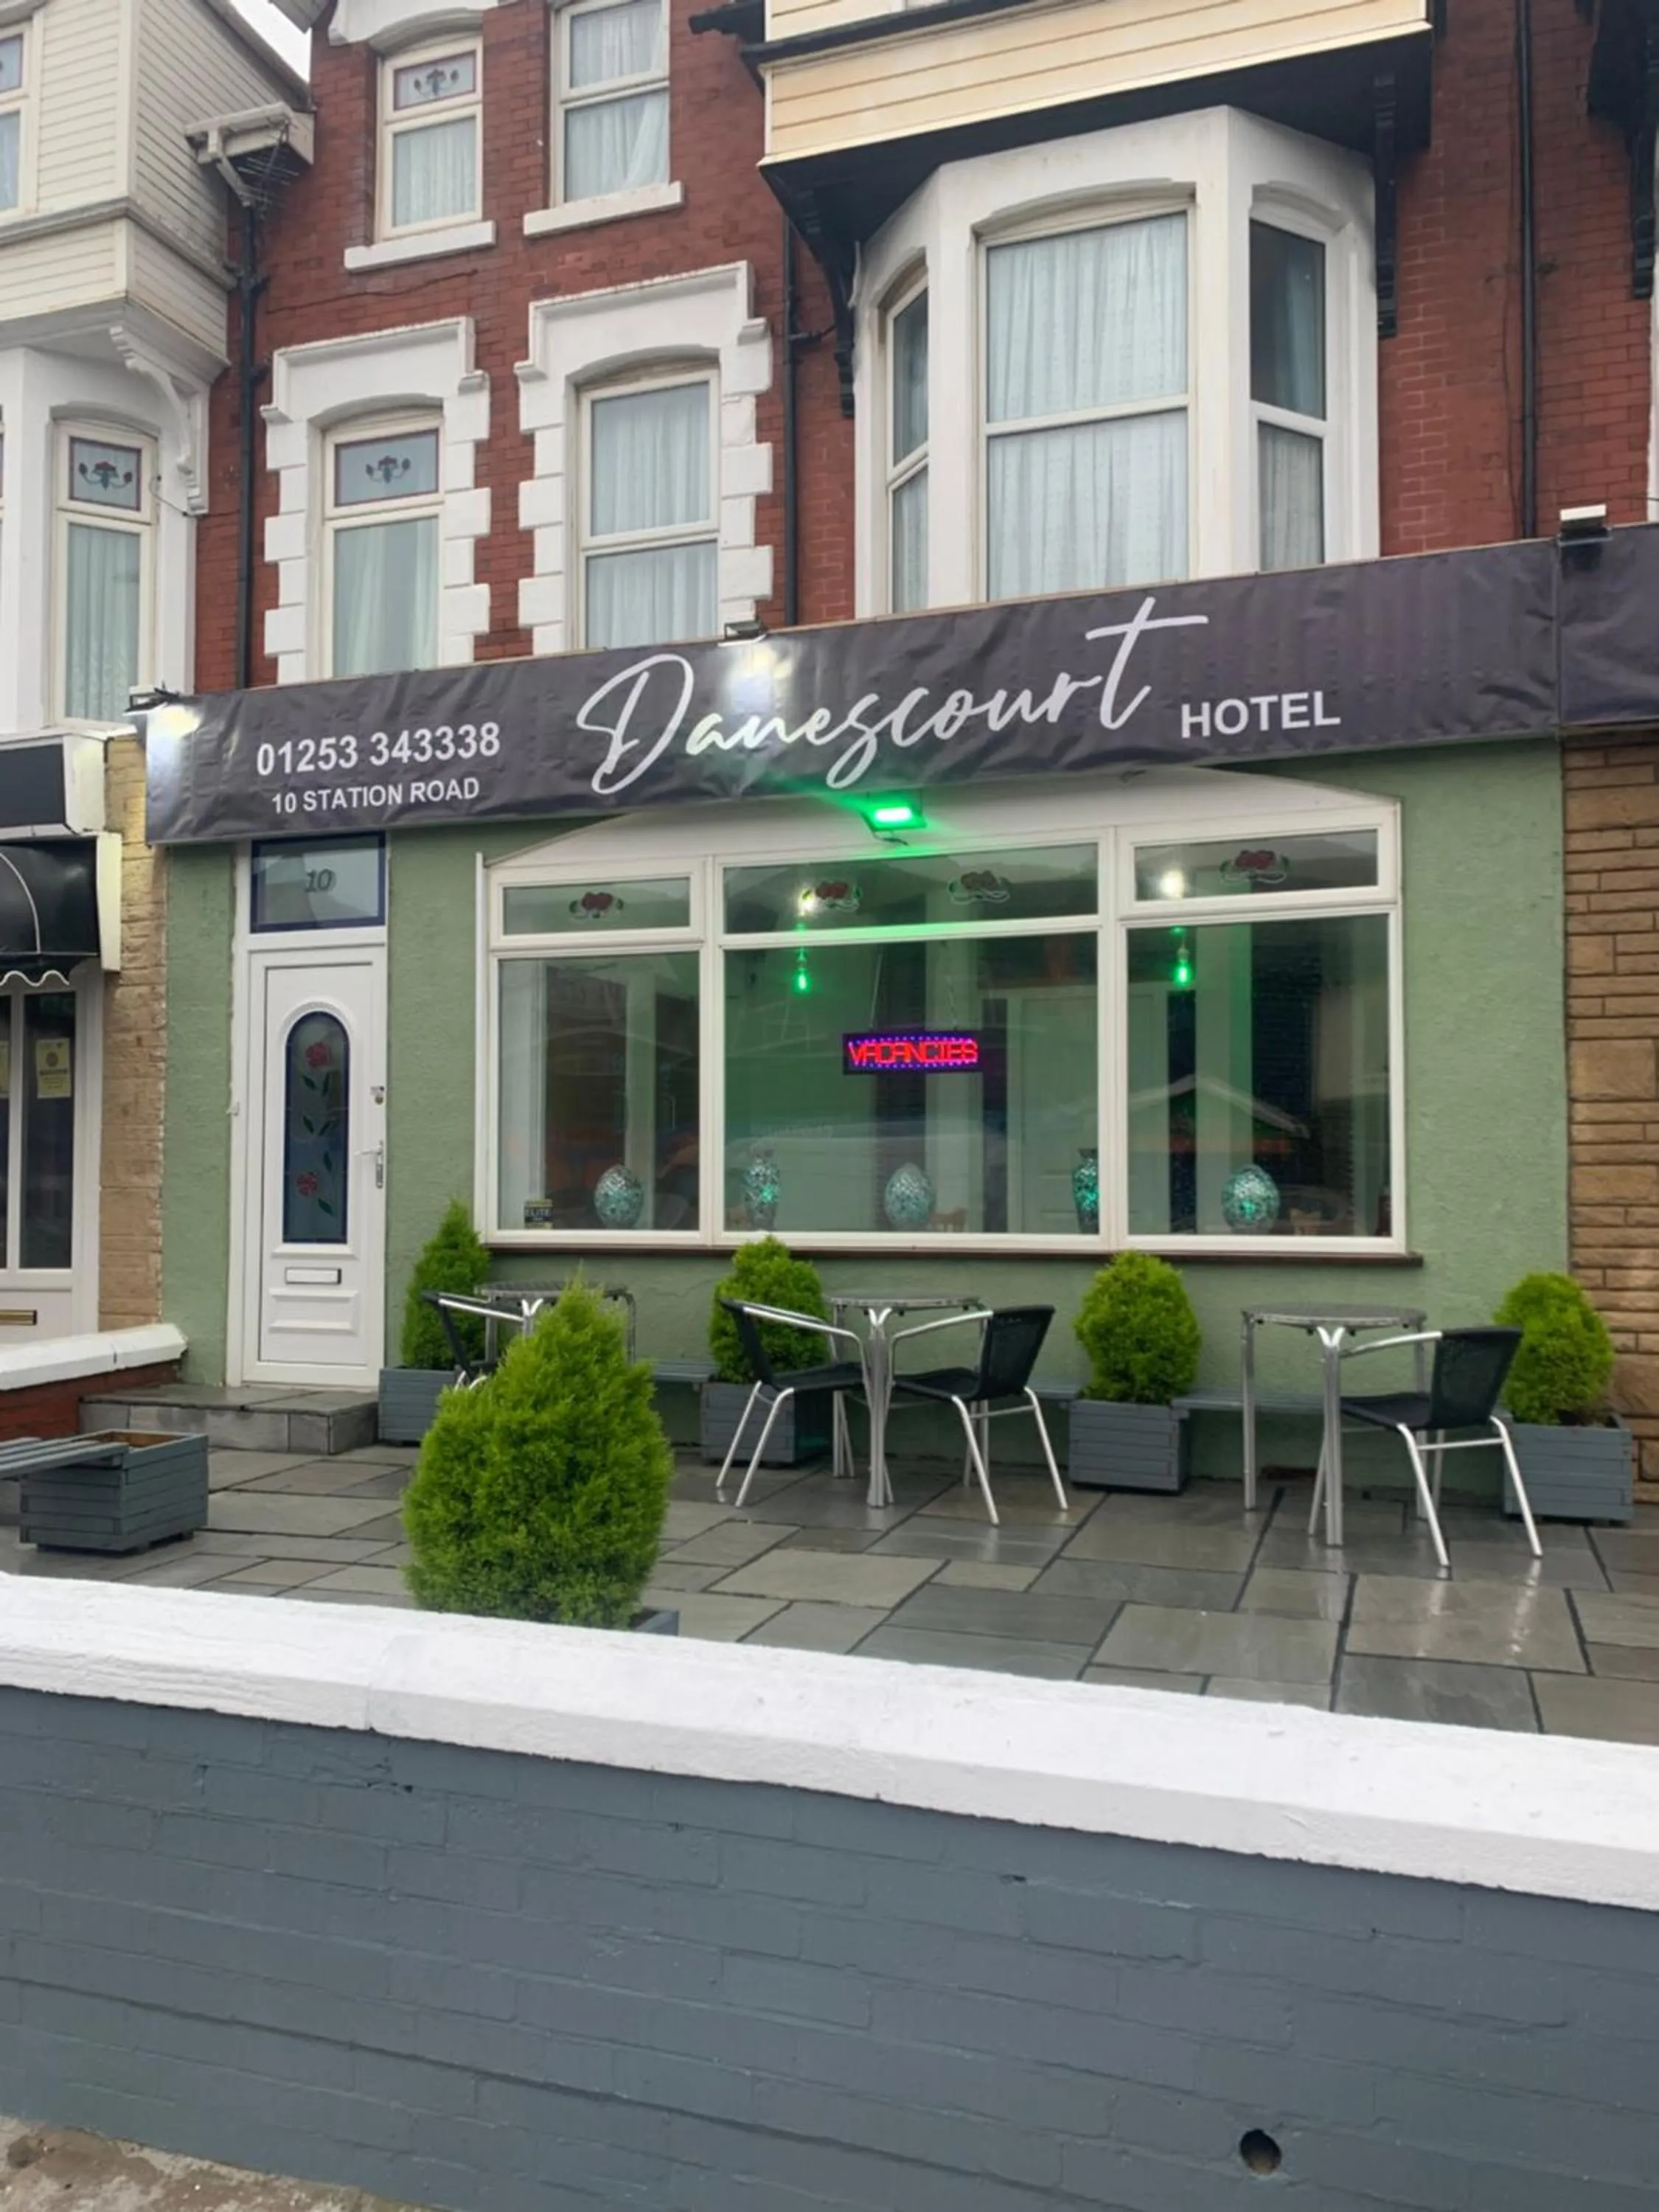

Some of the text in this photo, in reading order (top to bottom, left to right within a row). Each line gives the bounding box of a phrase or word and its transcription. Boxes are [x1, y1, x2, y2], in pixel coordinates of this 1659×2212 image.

[576, 597, 1341, 794] Danescourt HOTEL
[257, 722, 501, 776] 01253 343338
[272, 778, 479, 814] 10 STATION ROAD
[304, 869, 337, 893] 10
[849, 1040, 978, 1066] VACANCIES
